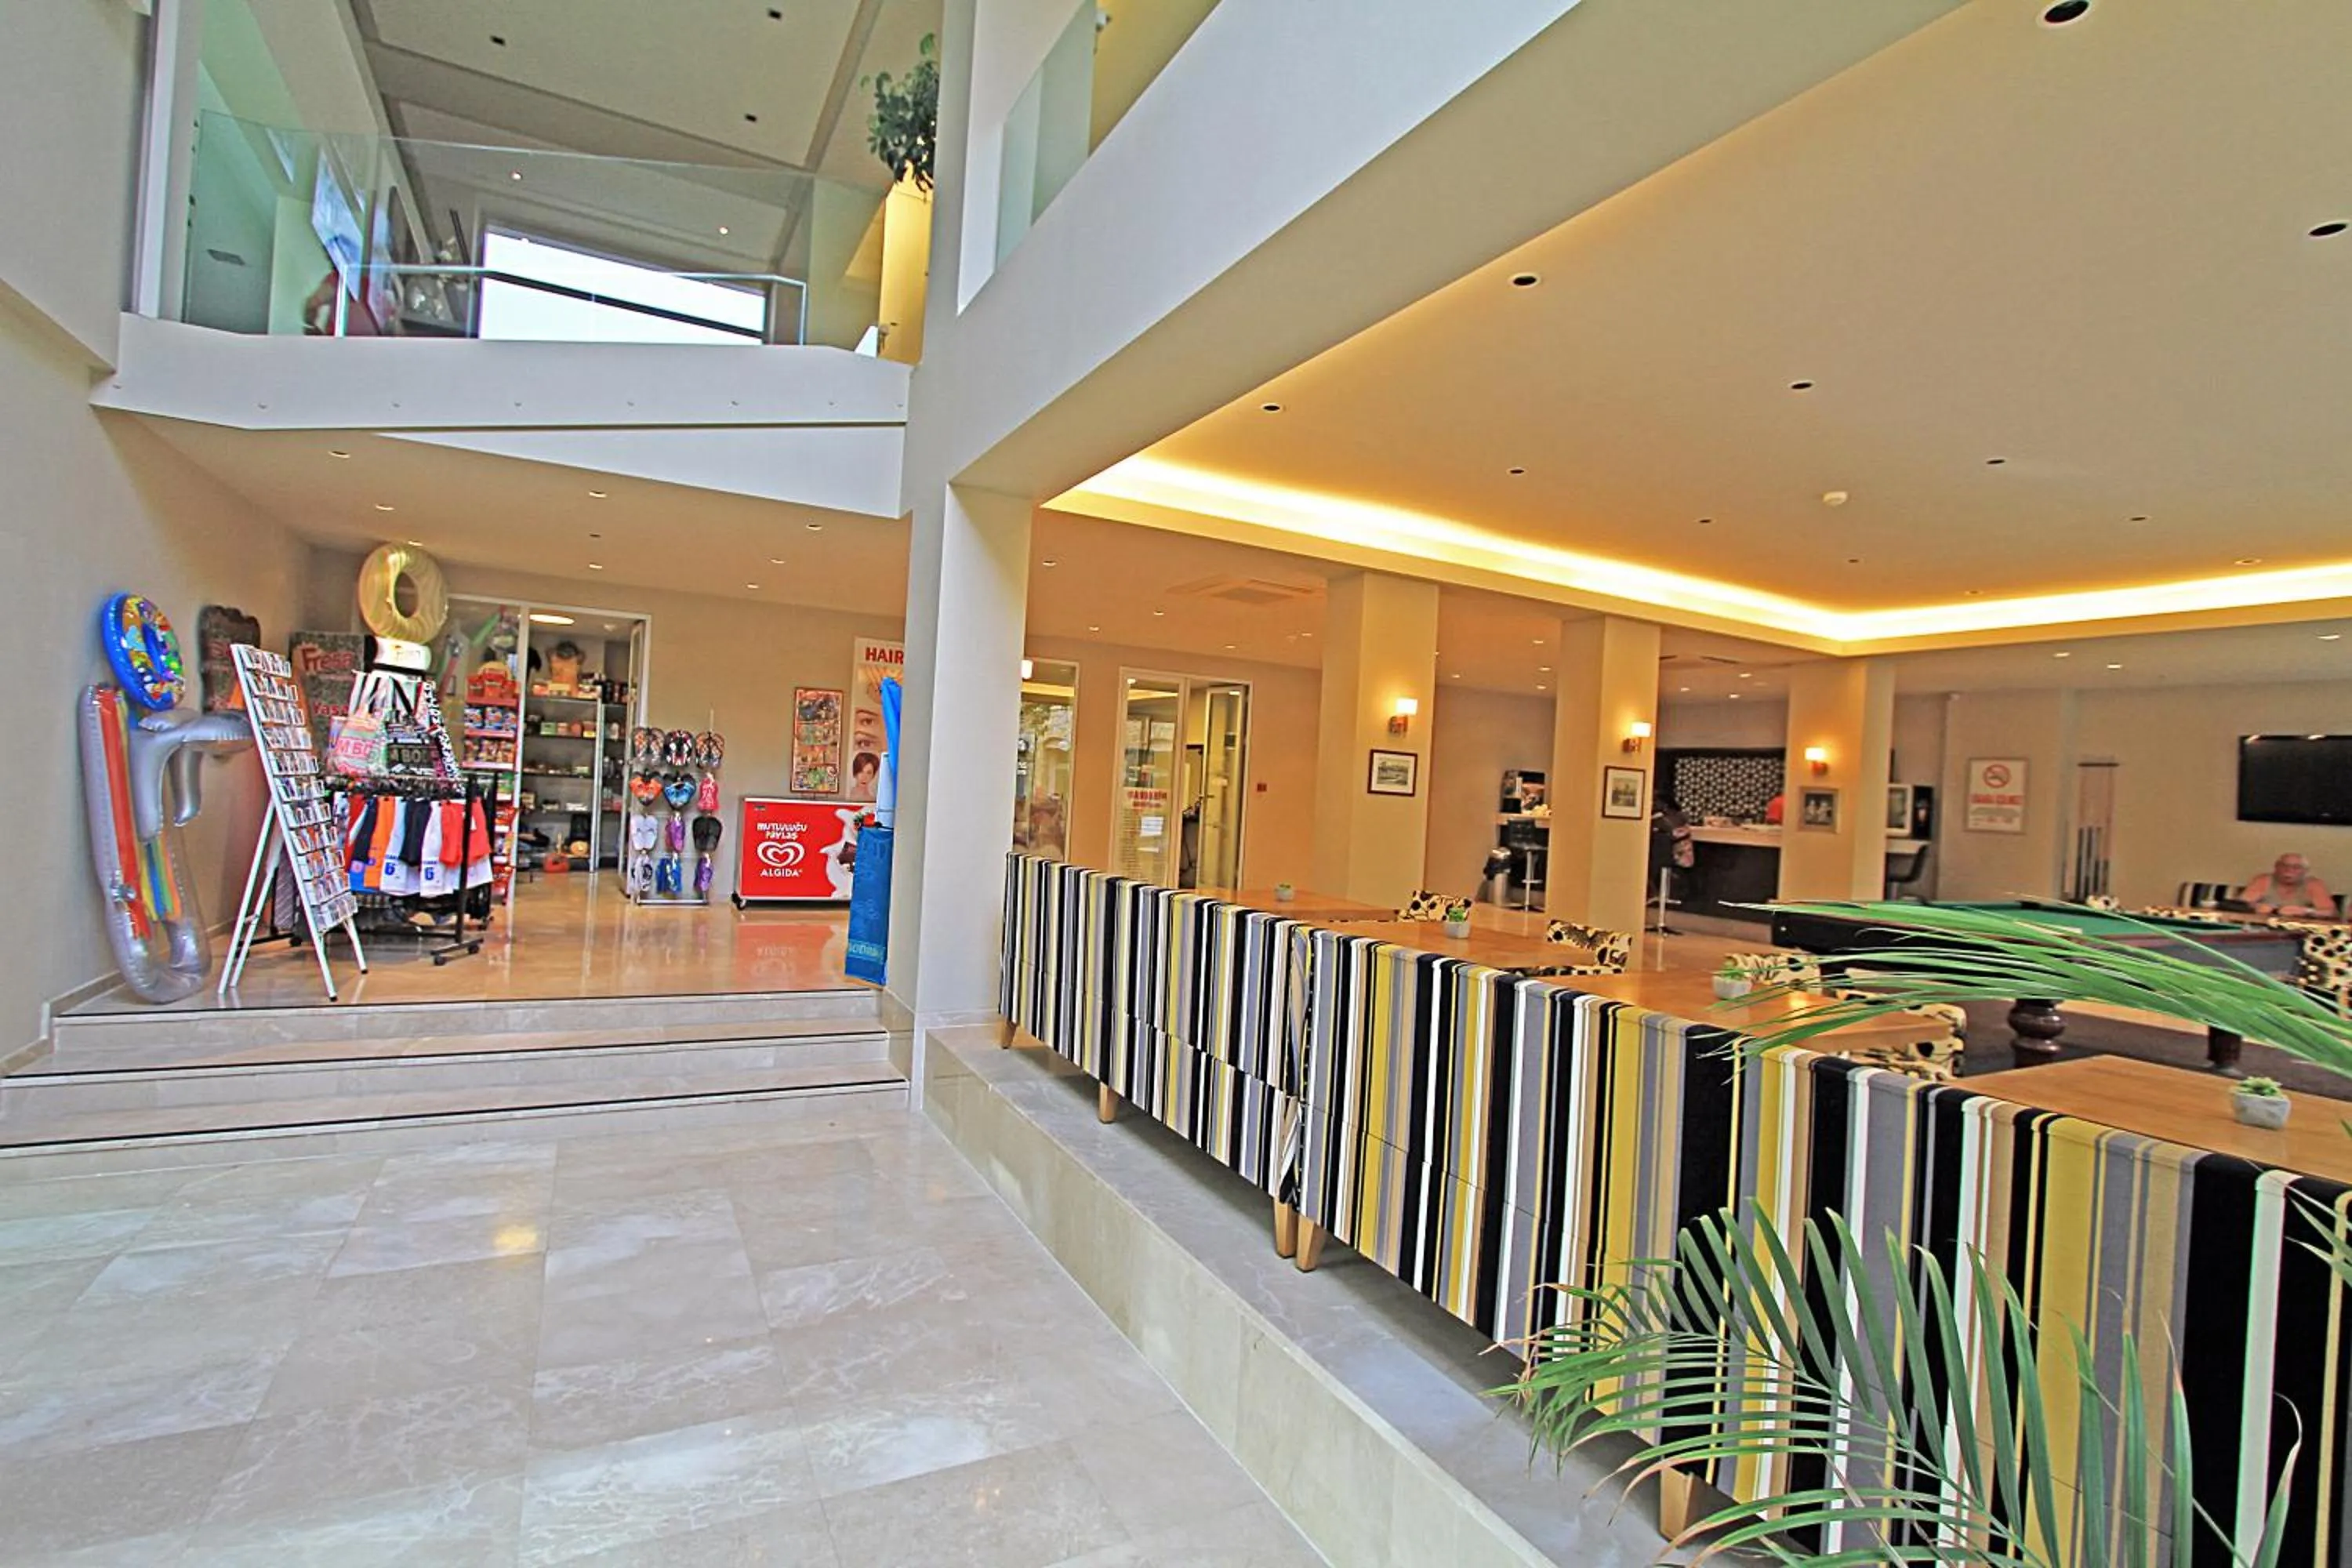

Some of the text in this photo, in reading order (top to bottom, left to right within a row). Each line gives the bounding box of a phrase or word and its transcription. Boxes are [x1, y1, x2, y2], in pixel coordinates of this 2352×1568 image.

[866, 647, 904, 665] HAIR
[424, 866, 434, 880] 6
[760, 868, 800, 878] ALGIDA
